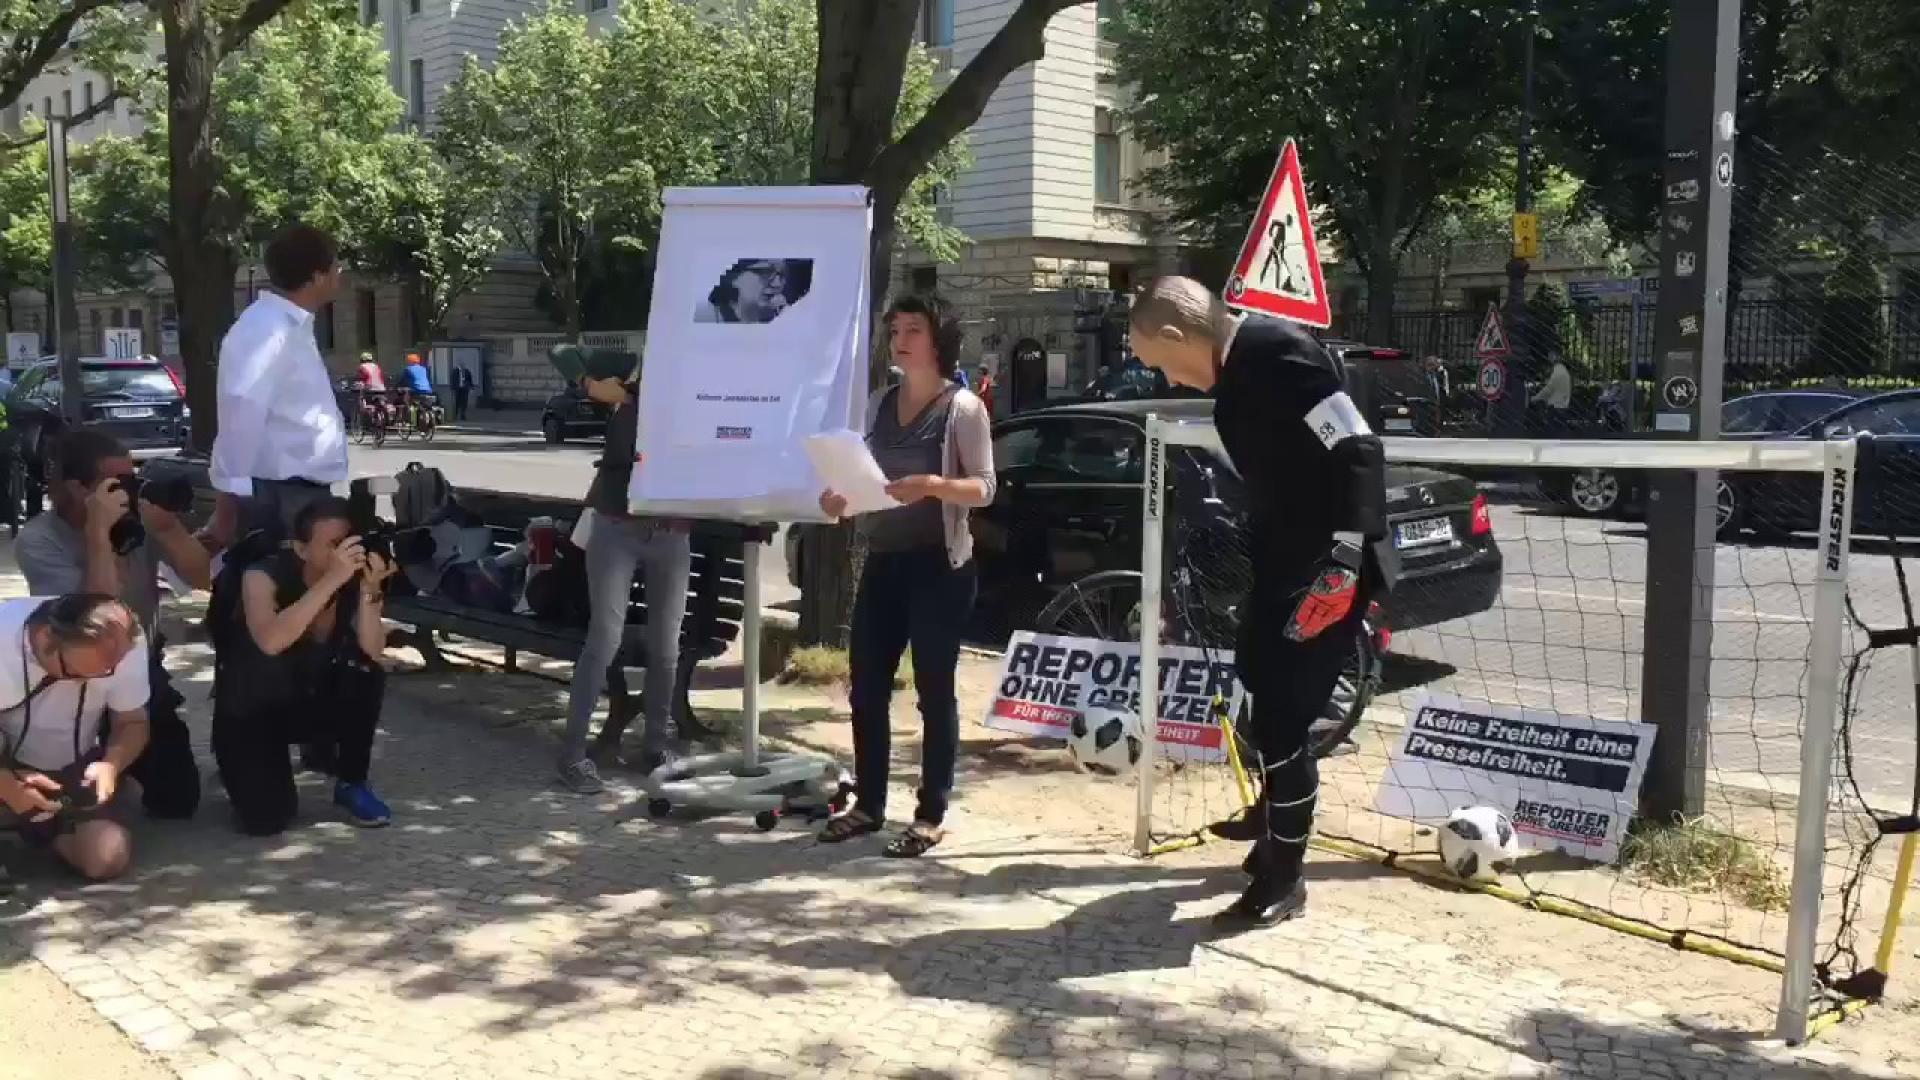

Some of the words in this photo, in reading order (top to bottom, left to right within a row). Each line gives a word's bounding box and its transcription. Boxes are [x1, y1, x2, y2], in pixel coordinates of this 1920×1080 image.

[1826, 467, 1848, 572] KICKSTER
[1001, 674, 1081, 708] OHNE
[1419, 708, 1480, 733] Keine
[1485, 718, 1571, 749] Freiheit
[1574, 733, 1633, 758] ohne
[1409, 735, 1567, 780] Pressefreiheit.
[1514, 799, 1610, 829] REPORTER
